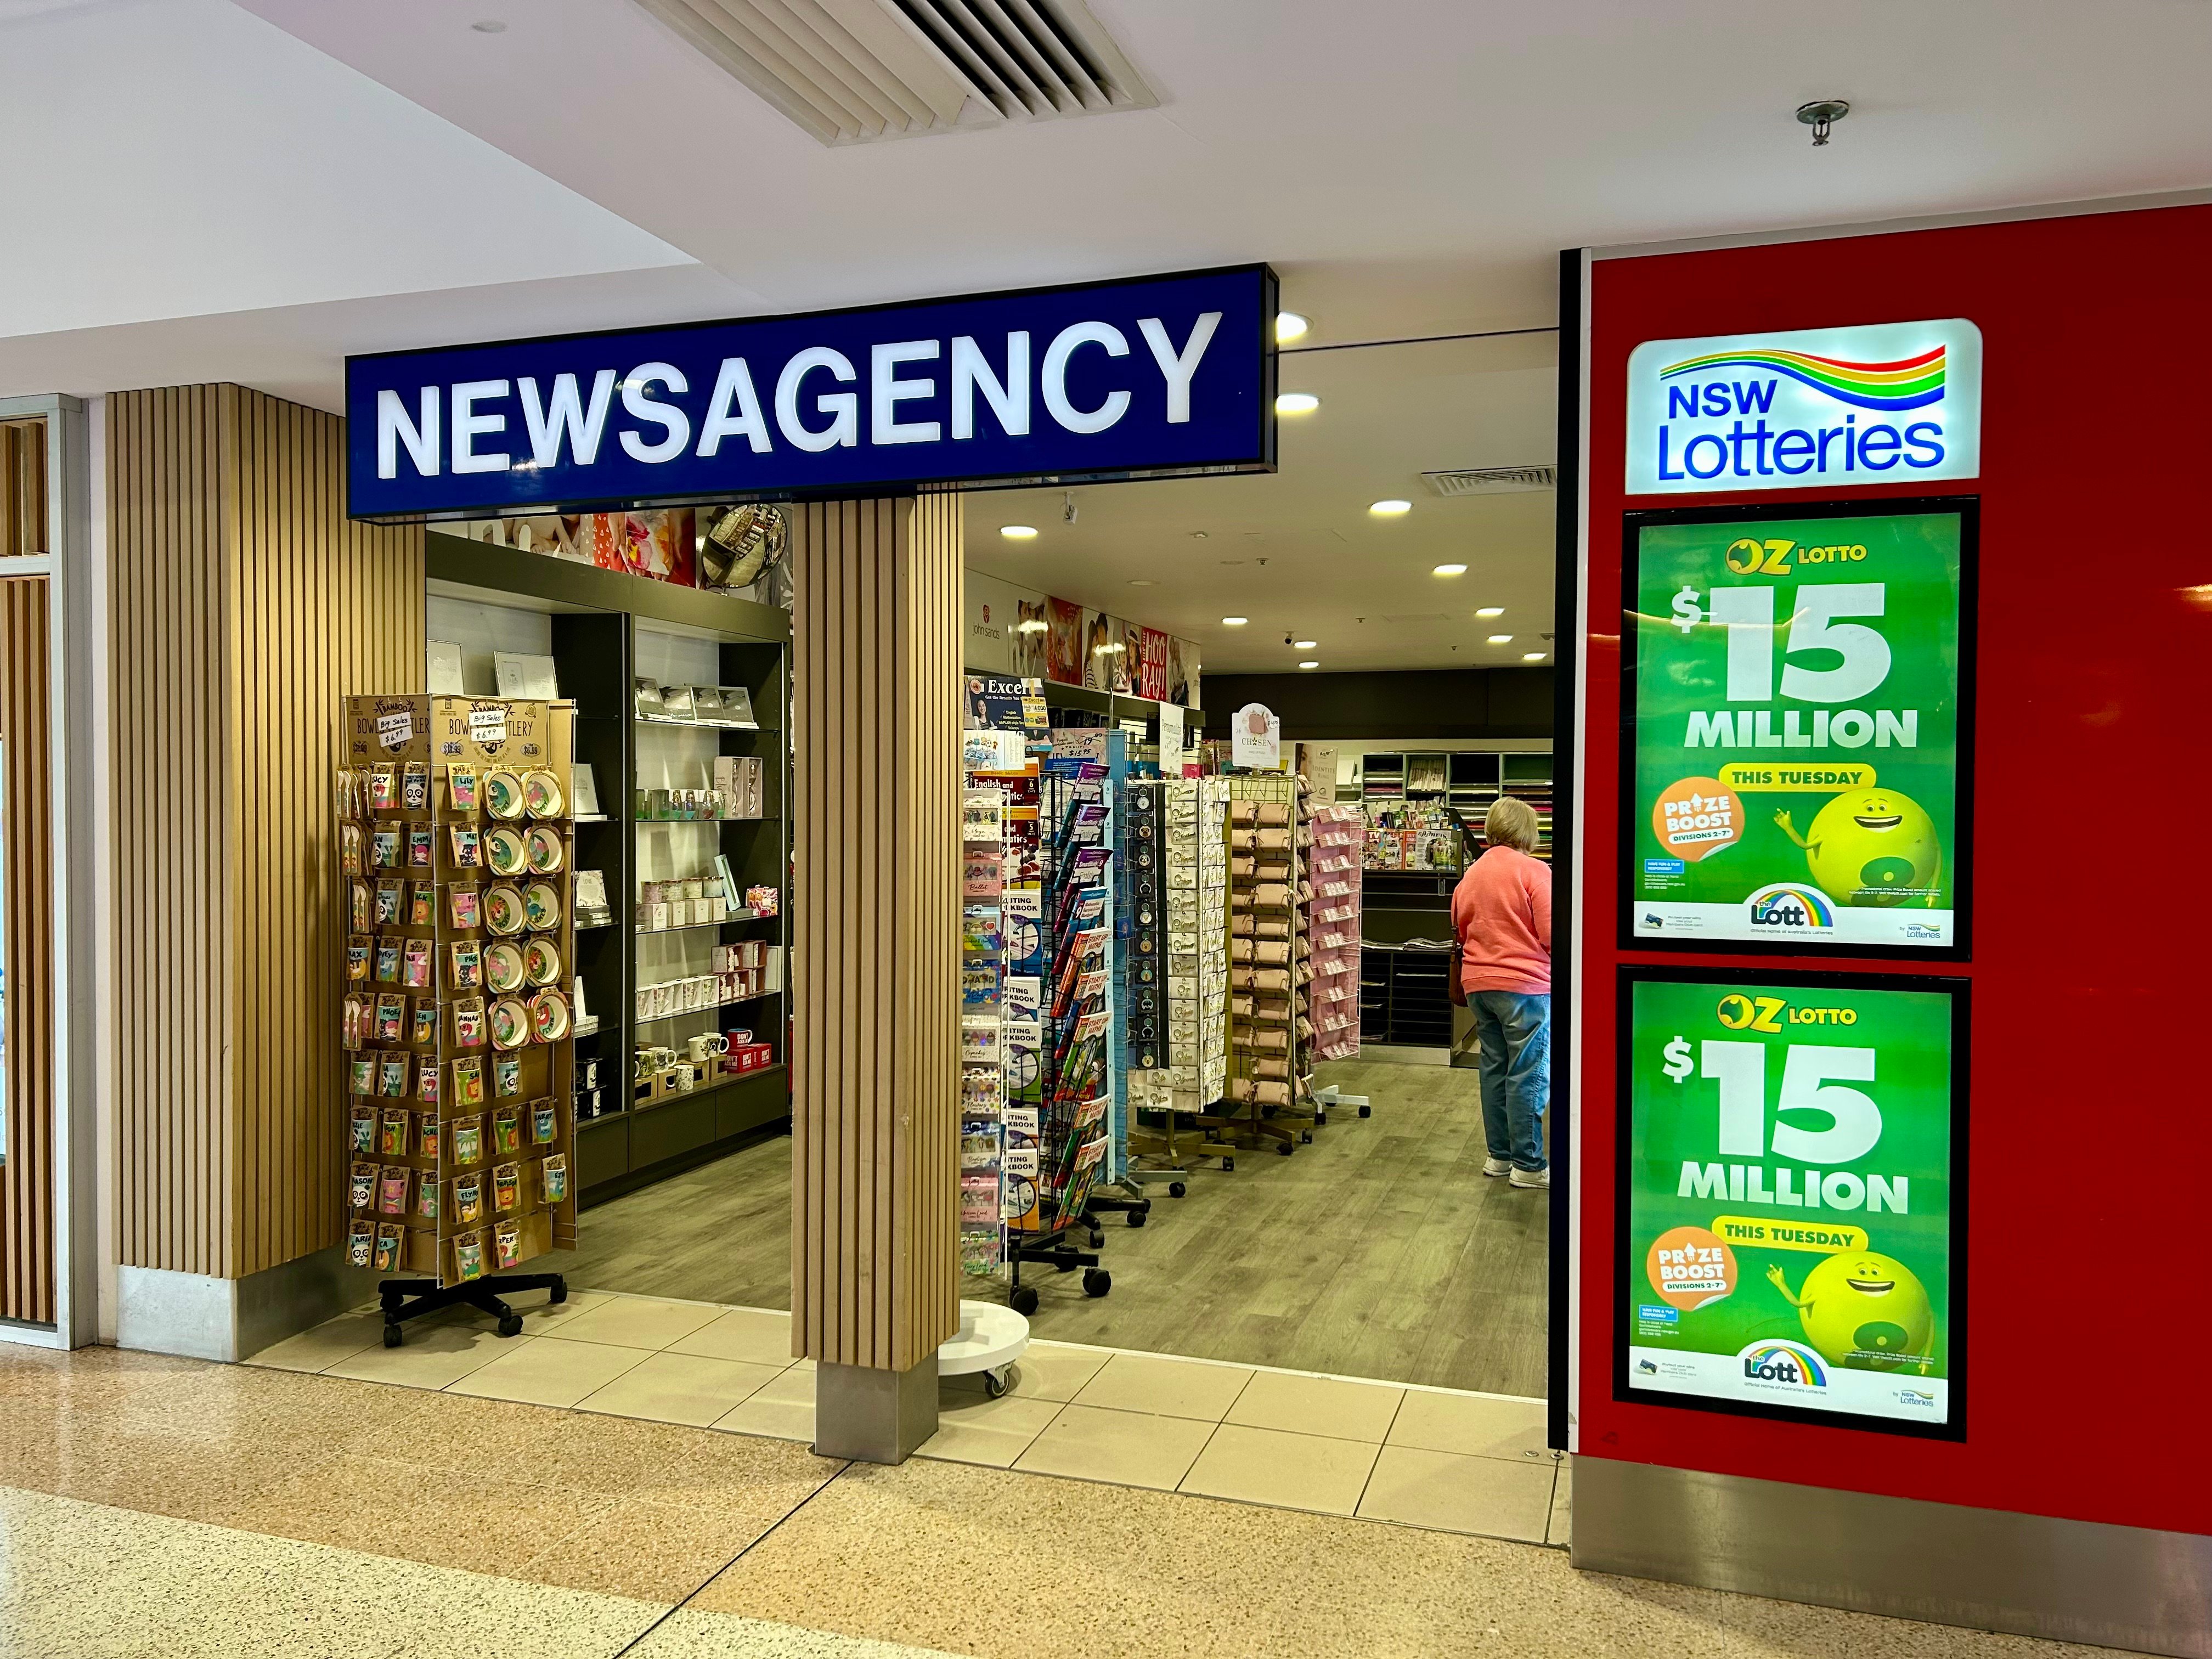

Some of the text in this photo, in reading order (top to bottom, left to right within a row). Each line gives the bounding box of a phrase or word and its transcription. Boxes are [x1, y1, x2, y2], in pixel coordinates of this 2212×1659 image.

[377, 312, 1223, 481] NEWSAGENCY
[1669, 379, 1778, 419] NSW
[1658, 414, 1945, 481] Lotteries
[1725, 538, 1867, 575] OZ LOTTO
[973, 622, 984, 636] john
[1145, 631, 1166, 665] HOO
[1671, 583, 1892, 703] $15
[1142, 662, 1165, 700] RAY!
[382, 702, 408, 713] BAMBOO
[380, 720, 391, 729] Big
[474, 715, 484, 724] Big
[1684, 709, 1918, 748] MILLION
[1002, 781, 1014, 789] and
[1732, 771, 1863, 785] THIS TUESDAY
[1666, 812, 1732, 832] BOOST
[1673, 833, 1712, 842] DIVISIONS
[415, 893, 428, 901] ACK
[1751, 905, 1804, 926] Lott
[1907, 930, 1940, 939] Lotteries
[1717, 994, 1858, 1034] OZ LOTTO
[1662, 1035, 1882, 1164] $15
[1677, 1160, 1908, 1215] MILLION
[1725, 1224, 1855, 1247] THIS TUESDAY
[1660, 1264, 1725, 1280] BOOST
[1745, 1358, 1798, 1384] Lott
[1900, 1396, 1933, 1407] Lotteries
